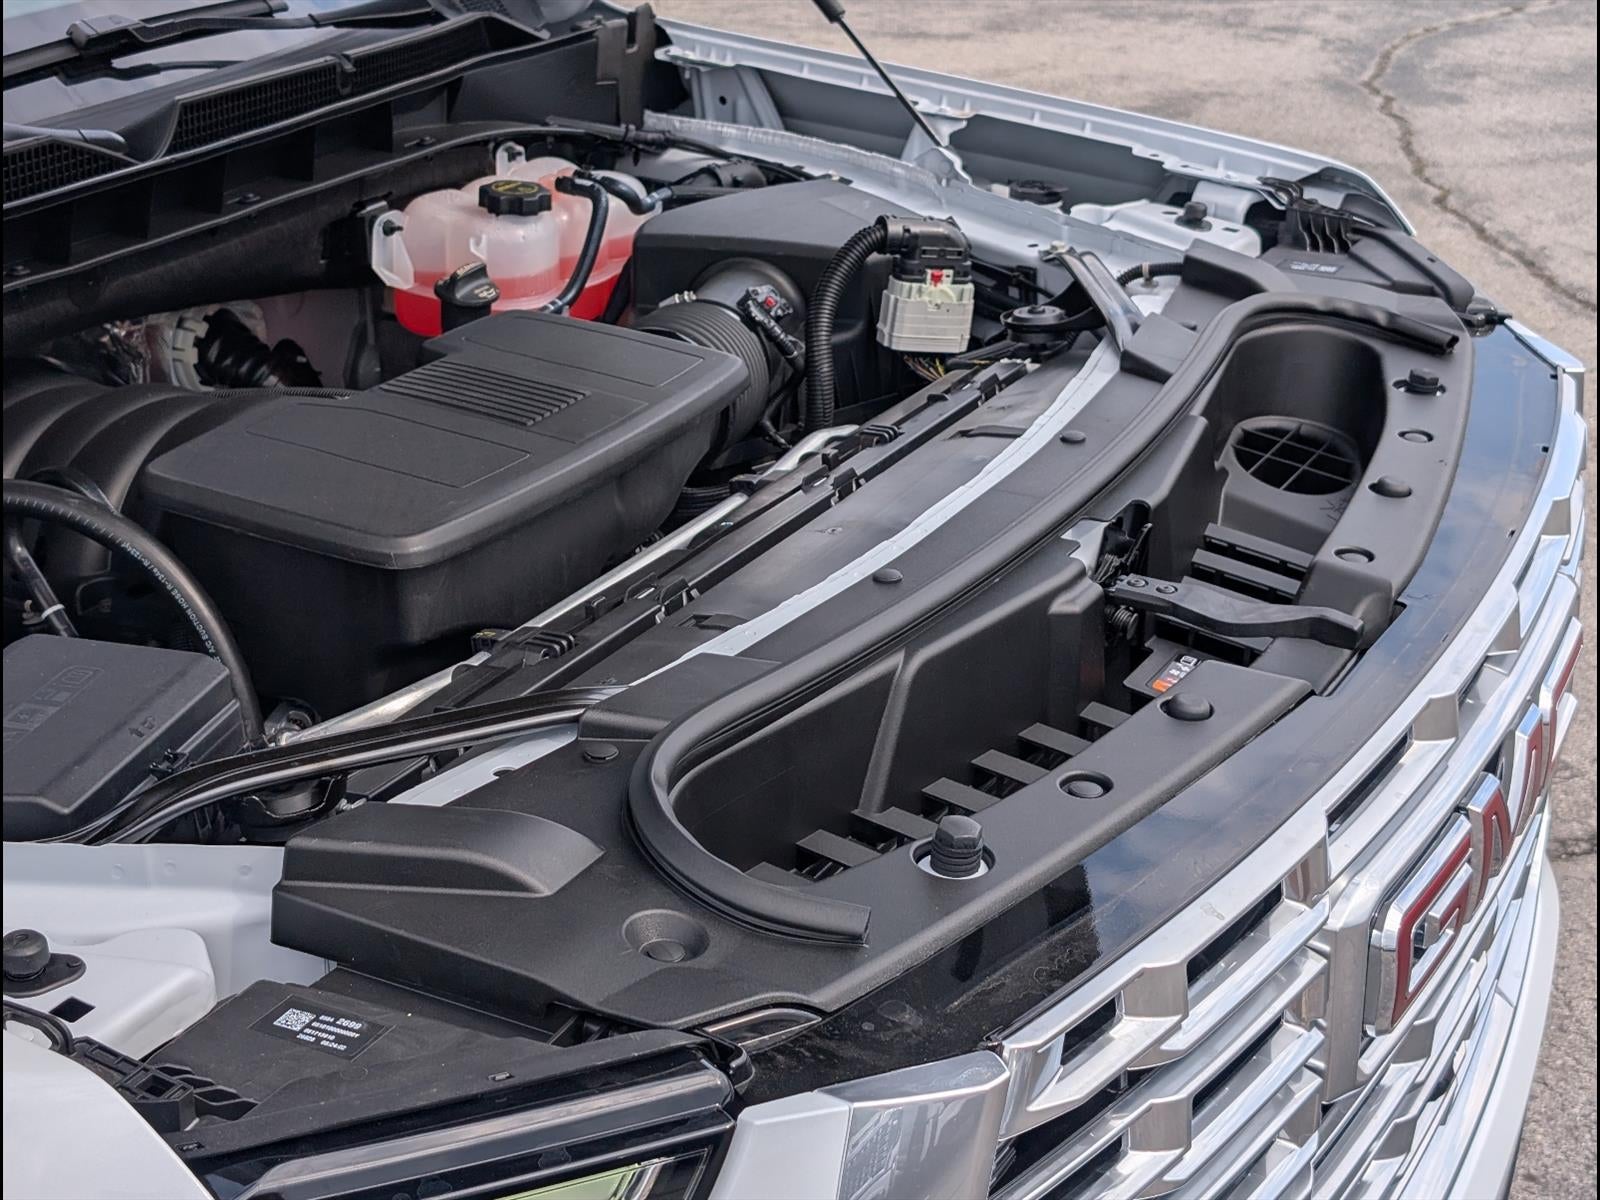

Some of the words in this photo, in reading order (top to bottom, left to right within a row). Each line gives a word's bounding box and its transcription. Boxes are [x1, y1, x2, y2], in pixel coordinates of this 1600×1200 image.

[153, 568, 174, 591] R-134a
[171, 588, 189, 609] HOSE
[186, 608, 209, 640] SUCTION
[205, 640, 216, 653] A/C
[1367, 616, 1583, 1034] GMC
[336, 1018, 362, 1030] 2699
